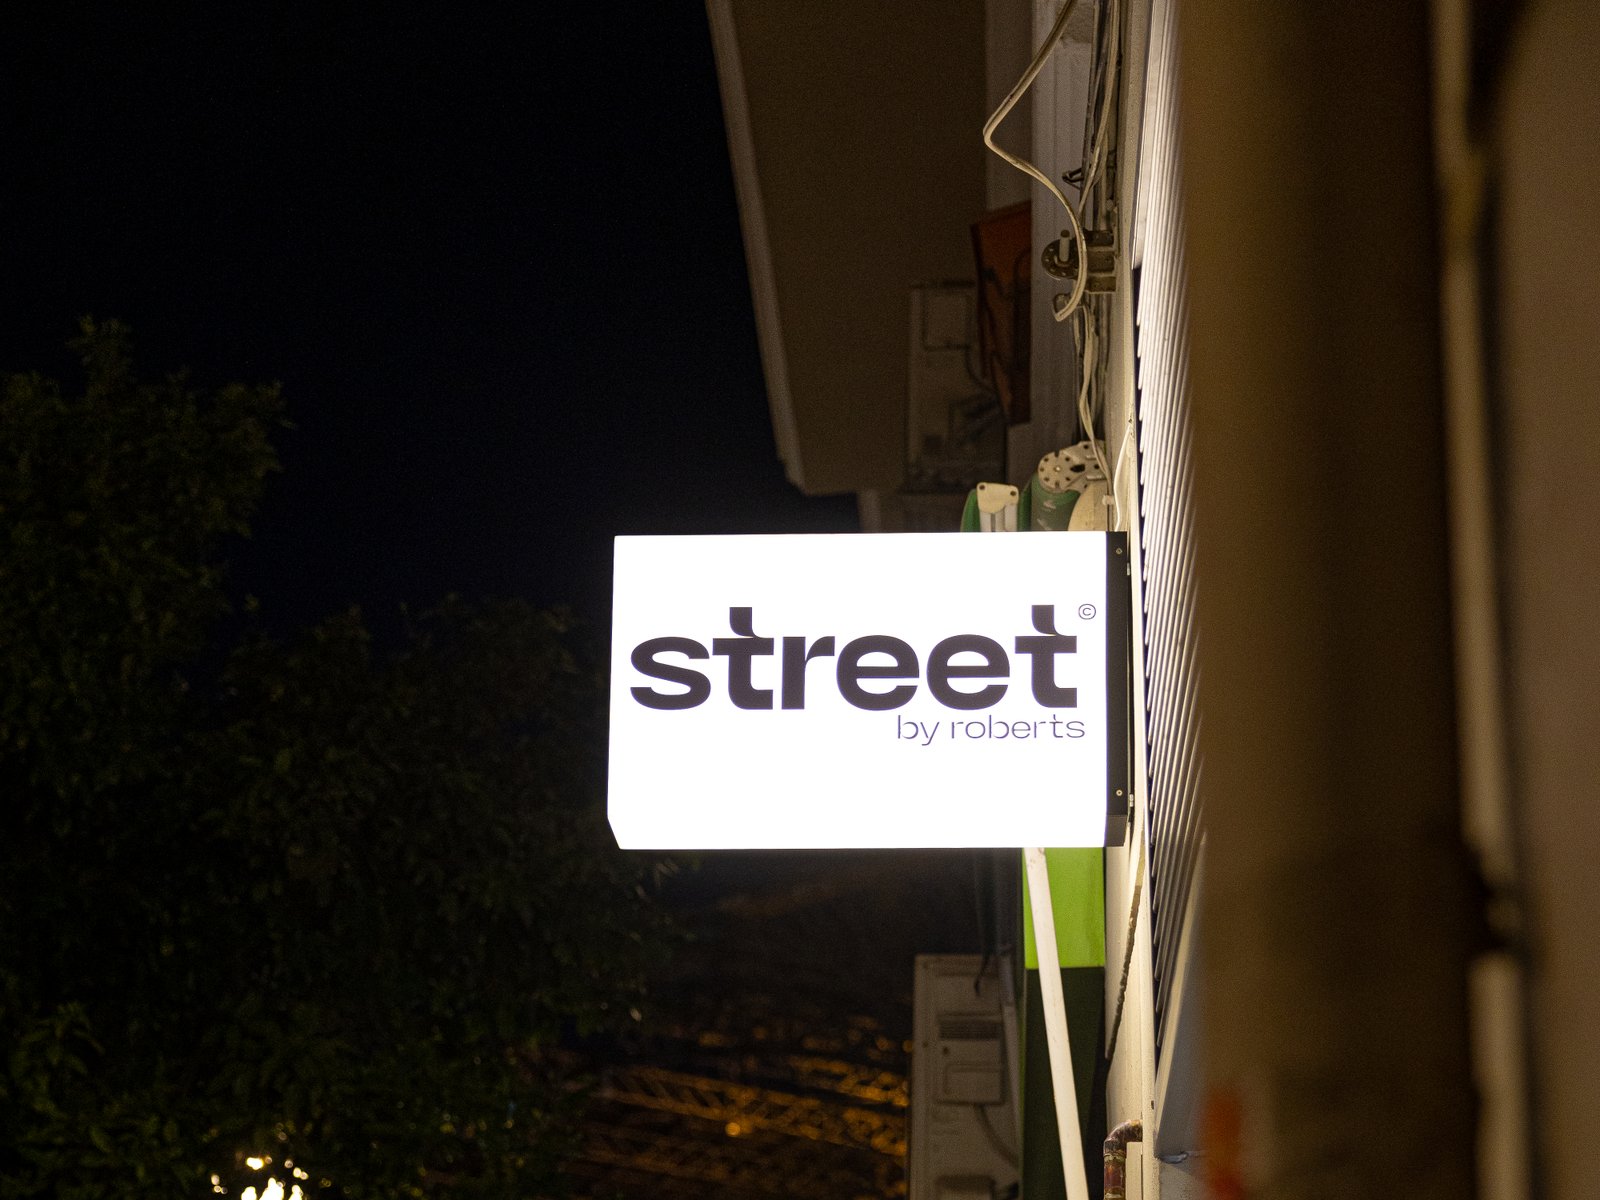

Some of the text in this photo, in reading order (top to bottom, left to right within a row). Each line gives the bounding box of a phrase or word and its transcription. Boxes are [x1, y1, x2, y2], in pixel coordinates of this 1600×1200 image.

[630, 604, 1077, 711] street
[897, 713, 1086, 746] by roberts
